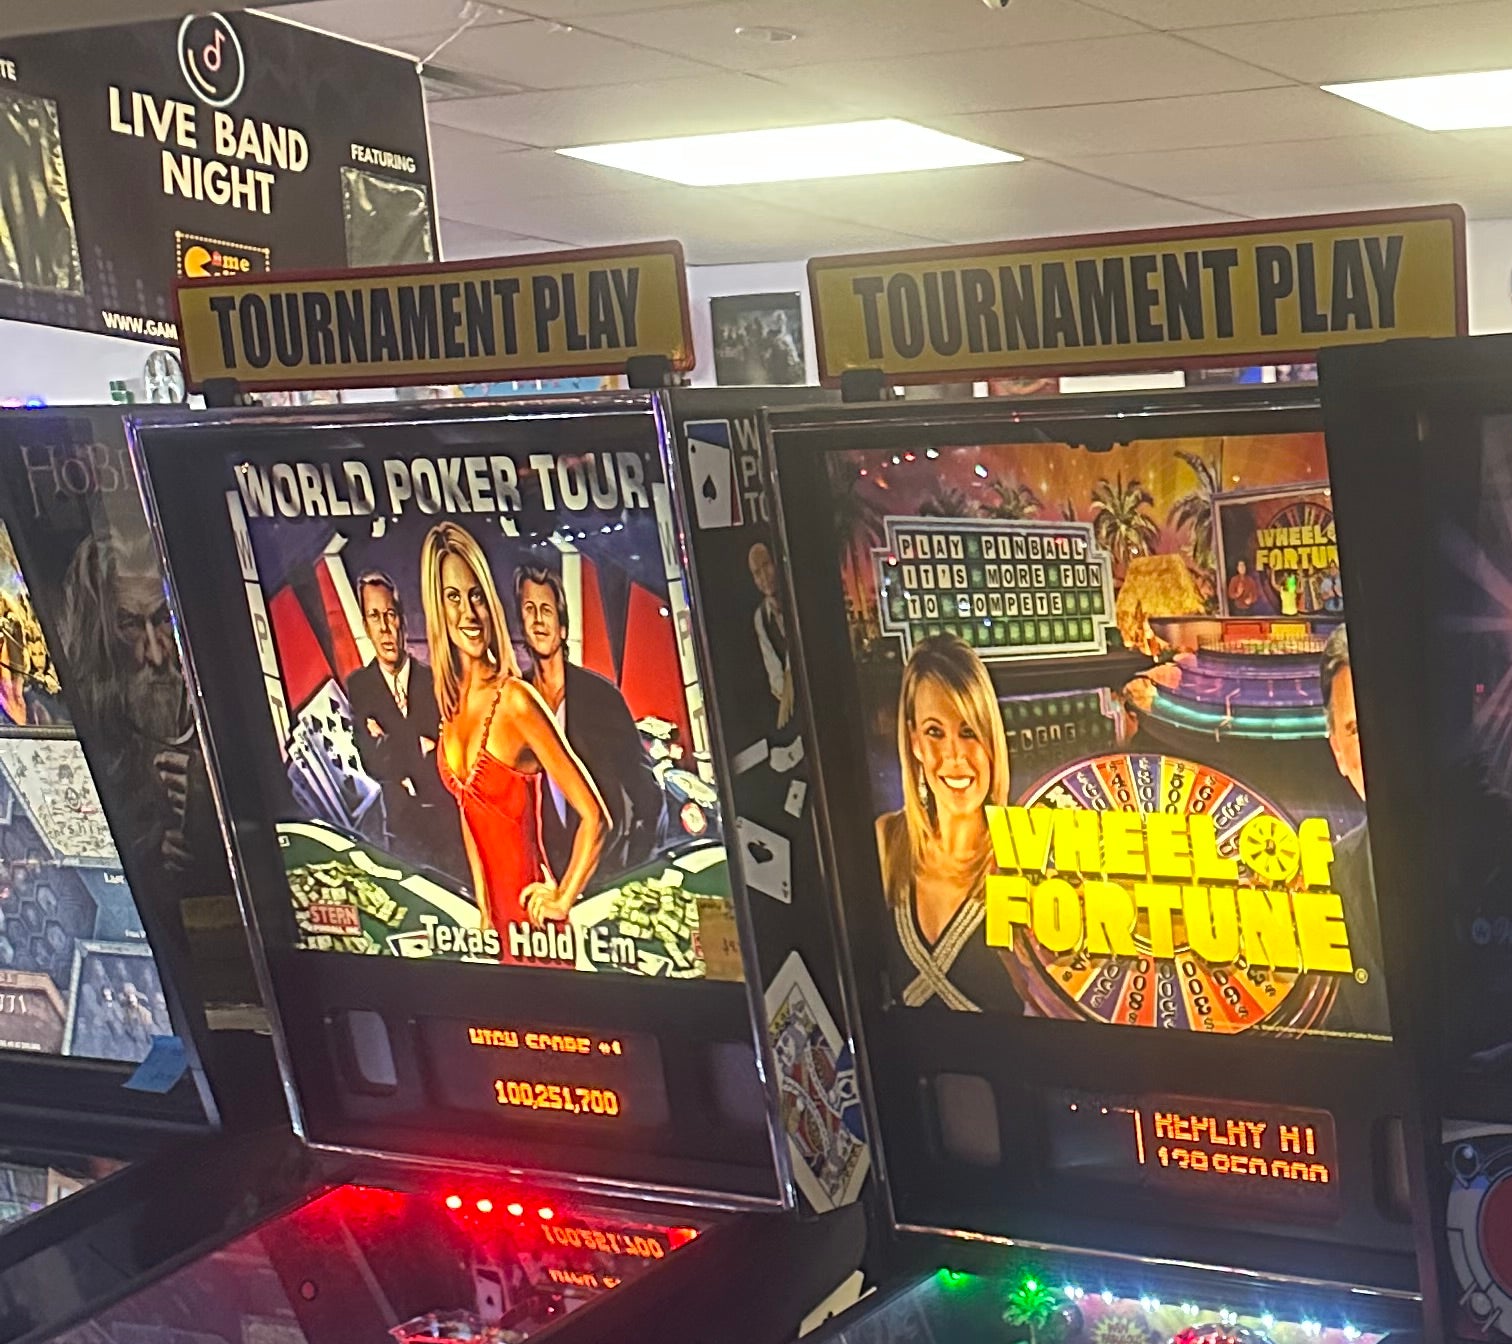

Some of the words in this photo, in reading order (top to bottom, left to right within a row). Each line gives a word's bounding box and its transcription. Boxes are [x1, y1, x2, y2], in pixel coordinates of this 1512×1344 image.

[109, 87, 196, 149] LIVE
[214, 112, 309, 172] BAND
[351, 143, 416, 174] FEATURING
[162, 150, 275, 215] NIGHT
[852, 246, 1240, 361] TOURNAMENT
[1253, 235, 1404, 336] PLAY
[102, 311, 179, 340] WWW.GAM
[210, 278, 520, 370] TOURNAMENT
[532, 268, 641, 352] PLAY
[235, 460, 375, 518] WORLD
[382, 455, 522, 513] POKER
[531, 452, 648, 512] TOUR
[902, 537, 961, 558] PLAY
[985, 539, 1084, 558] PINBALL
[1256, 525, 1328, 548] WHEEL
[907, 568, 966, 586] IT'S
[988, 567, 1043, 586] MORE
[1062, 567, 1100, 586] FUN
[1256, 545, 1339, 572] FORTUN
[911, 598, 936, 615] TO
[959, 595, 1061, 614] COMPETE
[984, 804, 1240, 883] WHEEL
[309, 904, 359, 926] STERN
[985, 875, 1355, 974] FORTUNE
[420, 915, 500, 955] Texas
[508, 922, 574, 960] Hold
[494, 1079, 619, 1115] 100,251,700
